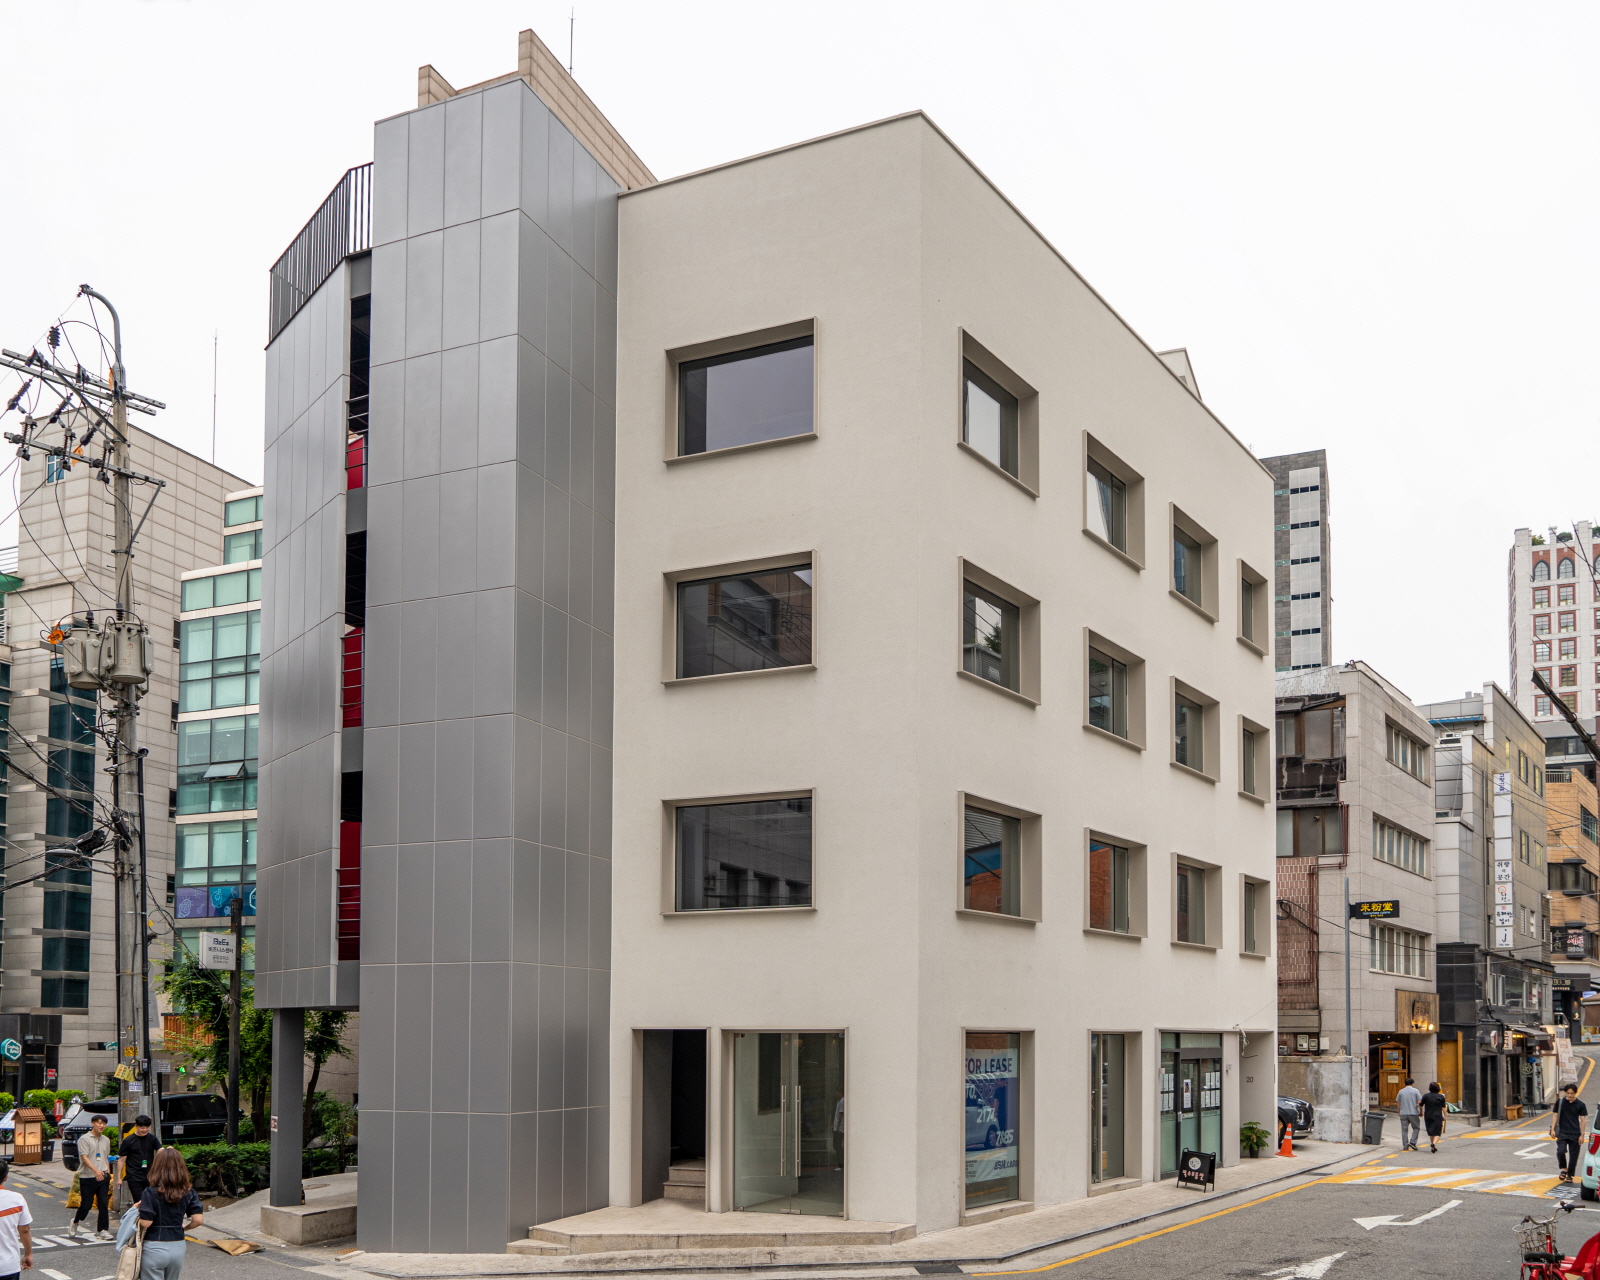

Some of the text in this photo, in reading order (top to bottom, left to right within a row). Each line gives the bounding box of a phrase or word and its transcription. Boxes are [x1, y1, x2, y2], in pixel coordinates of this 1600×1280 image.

[1360, 902, 1393, 912] 米粉堂
[985, 1057, 1012, 1073] LEASE
